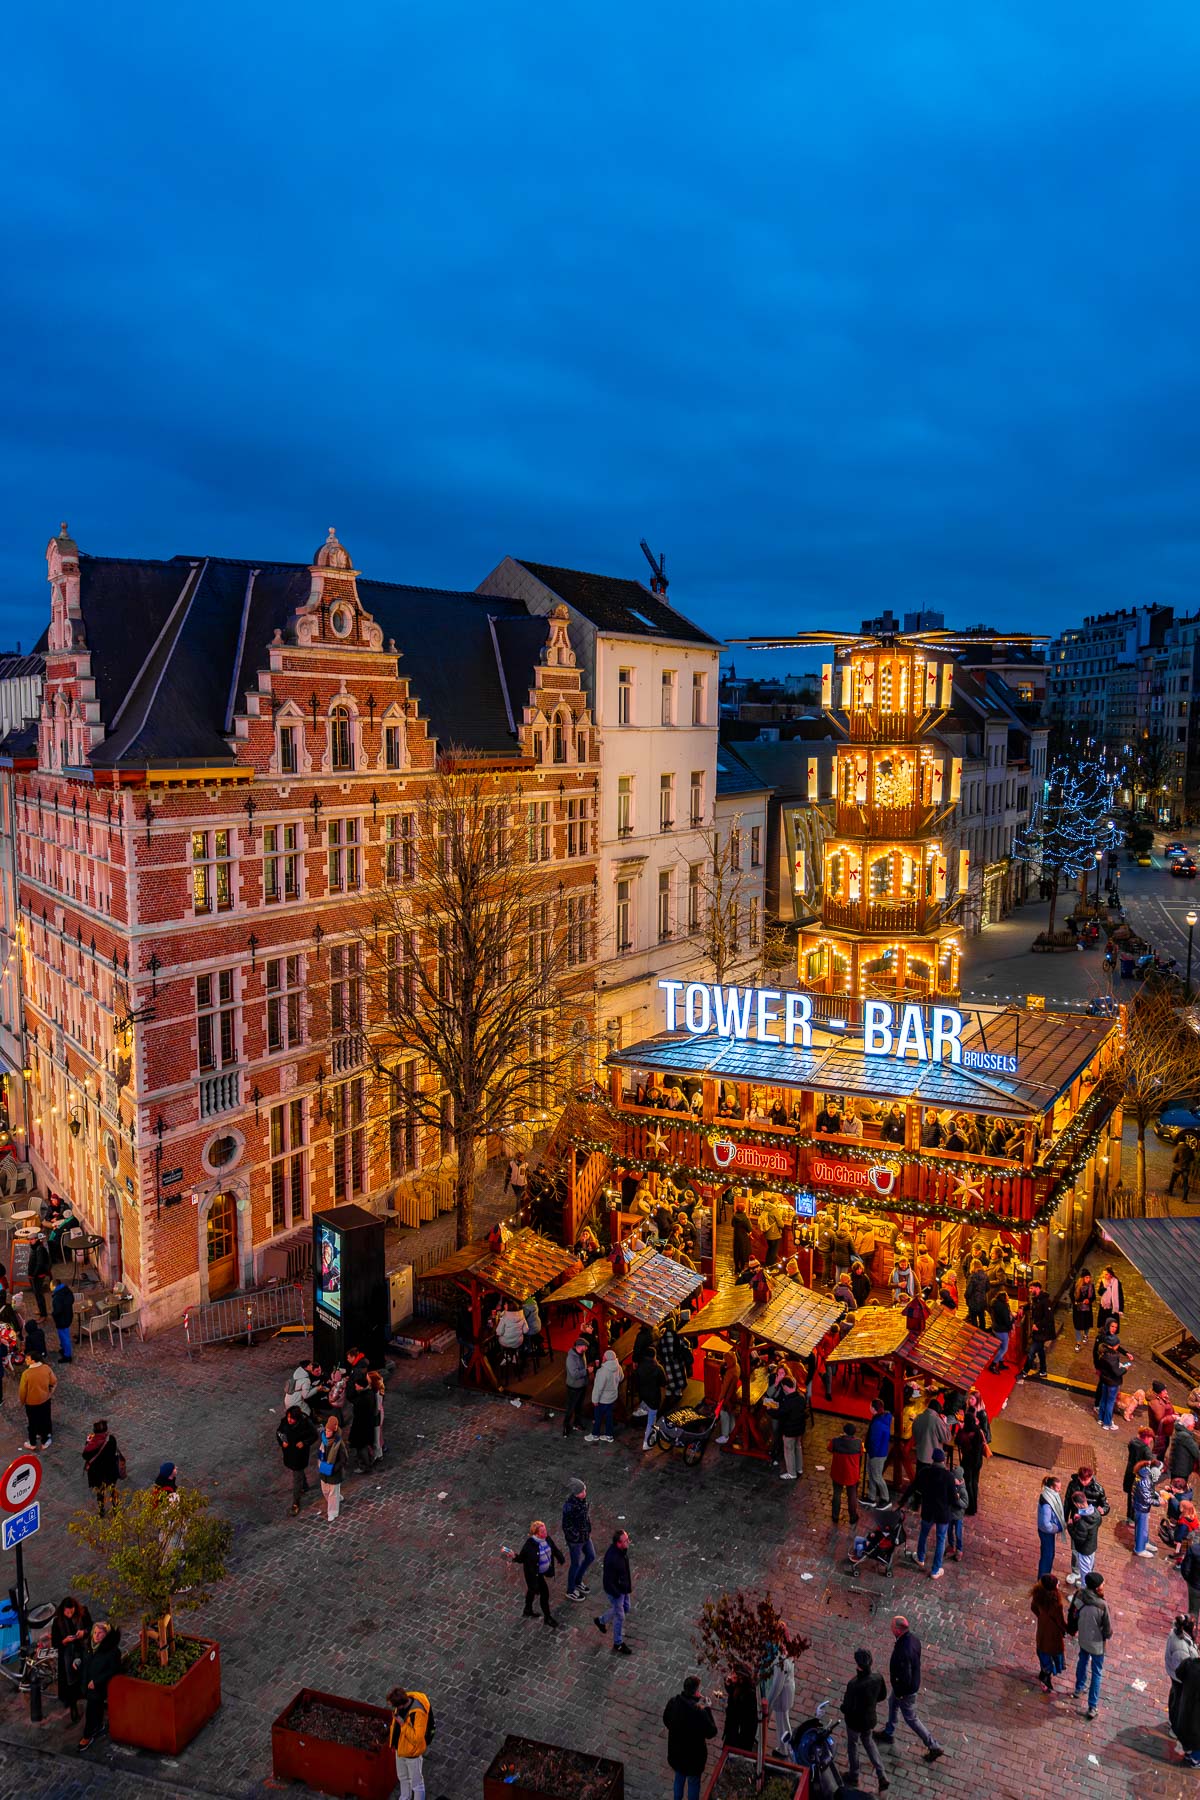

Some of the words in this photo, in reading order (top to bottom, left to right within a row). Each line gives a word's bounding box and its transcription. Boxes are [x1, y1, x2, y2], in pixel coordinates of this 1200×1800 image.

[658, 979, 813, 1048] TOWER
[864, 1000, 962, 1065] BAR
[964, 1051, 1017, 1072] BRUSSELS
[735, 1148, 787, 1171] Glühwein
[813, 1162, 834, 1181] Vin
[834, 1165, 870, 1187] Chaud
